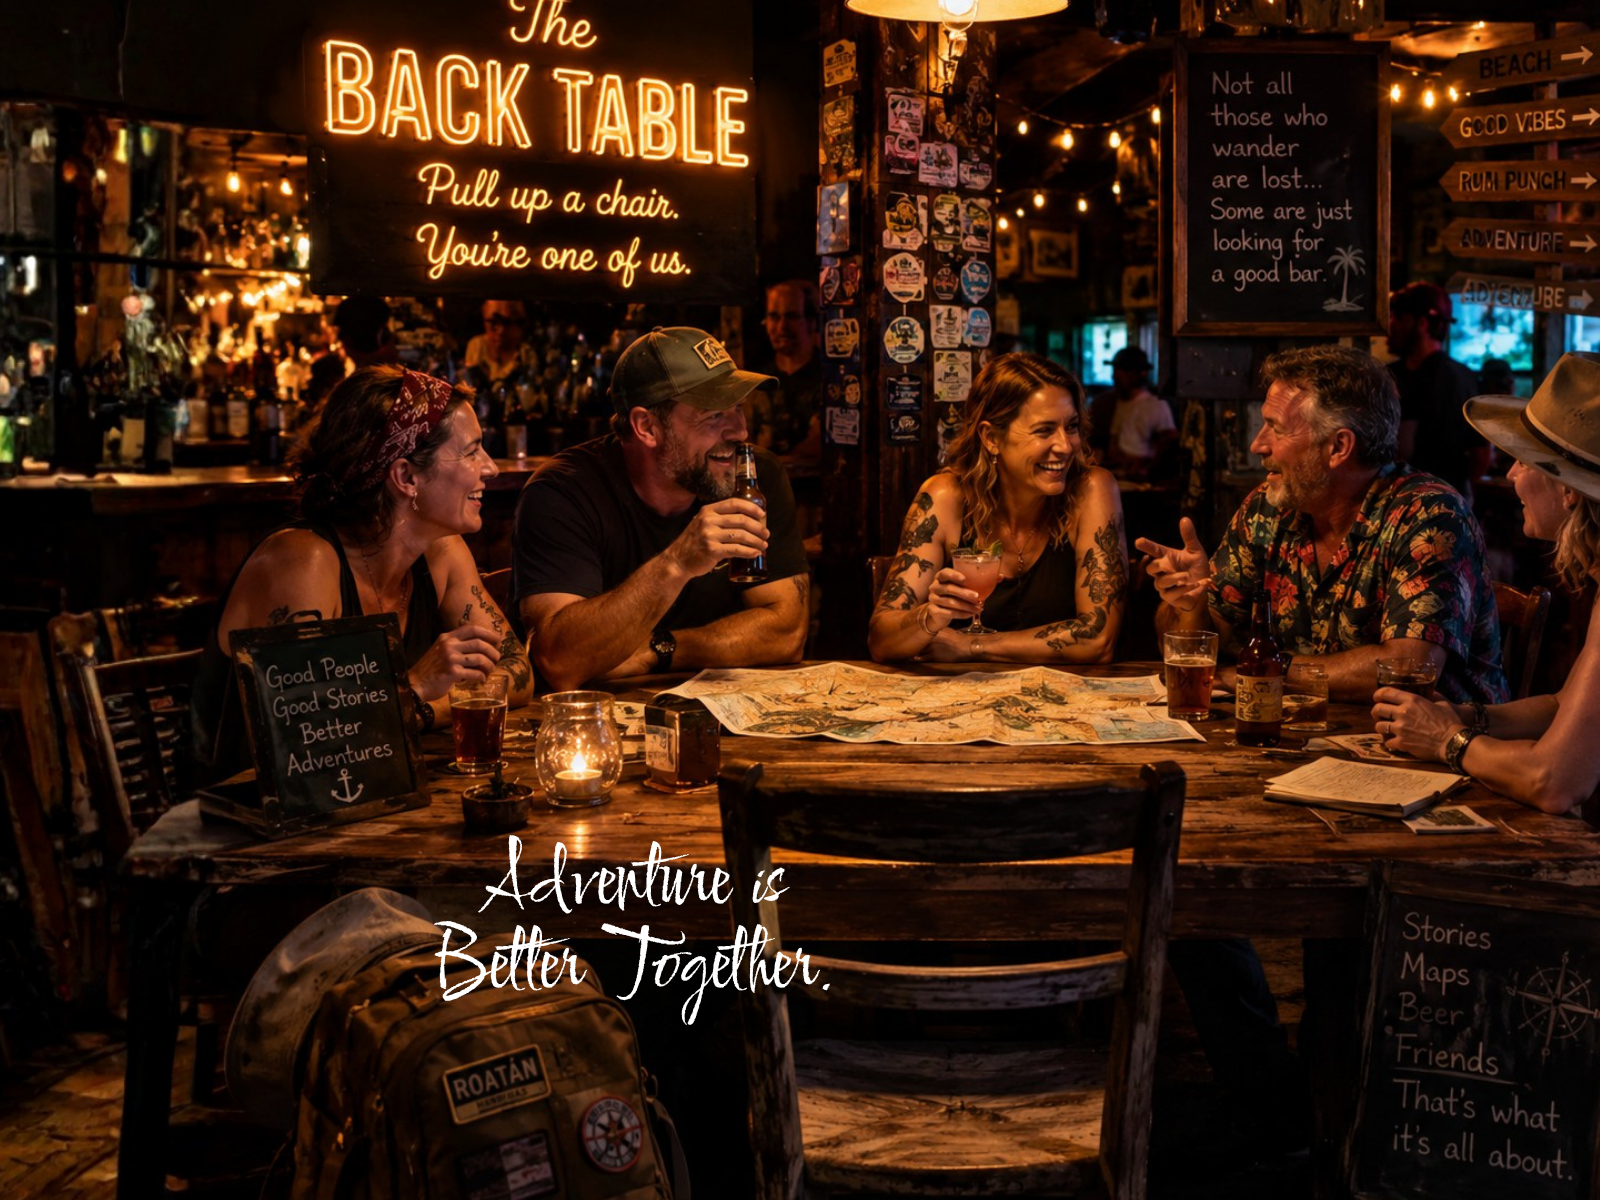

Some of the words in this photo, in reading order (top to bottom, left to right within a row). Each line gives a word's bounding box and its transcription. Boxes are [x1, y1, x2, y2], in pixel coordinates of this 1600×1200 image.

[509, 0, 597, 48] The
[1479, 50, 1551, 79] BEACH
[1211, 71, 1254, 95] Not
[1266, 71, 1293, 95] all
[323, 39, 531, 149] BACK
[552, 67, 749, 167] TABLE
[1210, 102, 1274, 127] those
[1284, 102, 1328, 126] who
[1460, 114, 1509, 138] GOOD
[1515, 108, 1566, 133] VIBES
[1211, 133, 1300, 157] wander
[418, 163, 499, 208] Pull
[510, 185, 552, 224] up
[562, 190, 585, 212] a
[596, 179, 679, 219] chair.
[1211, 173, 1250, 189] are
[1261, 165, 1322, 189] lost...
[1459, 171, 1498, 192] RUM
[1505, 170, 1566, 191] PUNCH
[1210, 197, 1265, 221] Some
[1273, 205, 1306, 221] are
[1312, 199, 1353, 230] just
[415, 222, 530, 280] You're
[541, 245, 597, 271] one
[607, 236, 641, 288] of
[650, 250, 692, 276] us.
[1213, 228, 1284, 260] looking
[1291, 228, 1325, 257] for
[1460, 228, 1564, 252] ADVENTURE
[1211, 268, 1225, 283] a
[1233, 260, 1280, 292] good
[1289, 260, 1327, 283] bar.
[266, 660, 315, 693] Good
[320, 653, 380, 684] People
[272, 691, 320, 725] Good
[326, 686, 388, 710] Stories
[299, 717, 362, 745] Better
[287, 743, 393, 777] Adventures
[1402, 911, 1492, 950] Stories
[1400, 951, 1471, 996] Maps
[1399, 991, 1464, 1025] Beer
[1395, 1033, 1500, 1076] Friends
[452, 1056, 539, 1101] ROATÁN
[1392, 1078, 1476, 1119] That's
[1491, 1094, 1561, 1133] what
[1393, 1123, 1431, 1155] it's
[1444, 1132, 1474, 1163] all
[1489, 1138, 1573, 1181] about.
